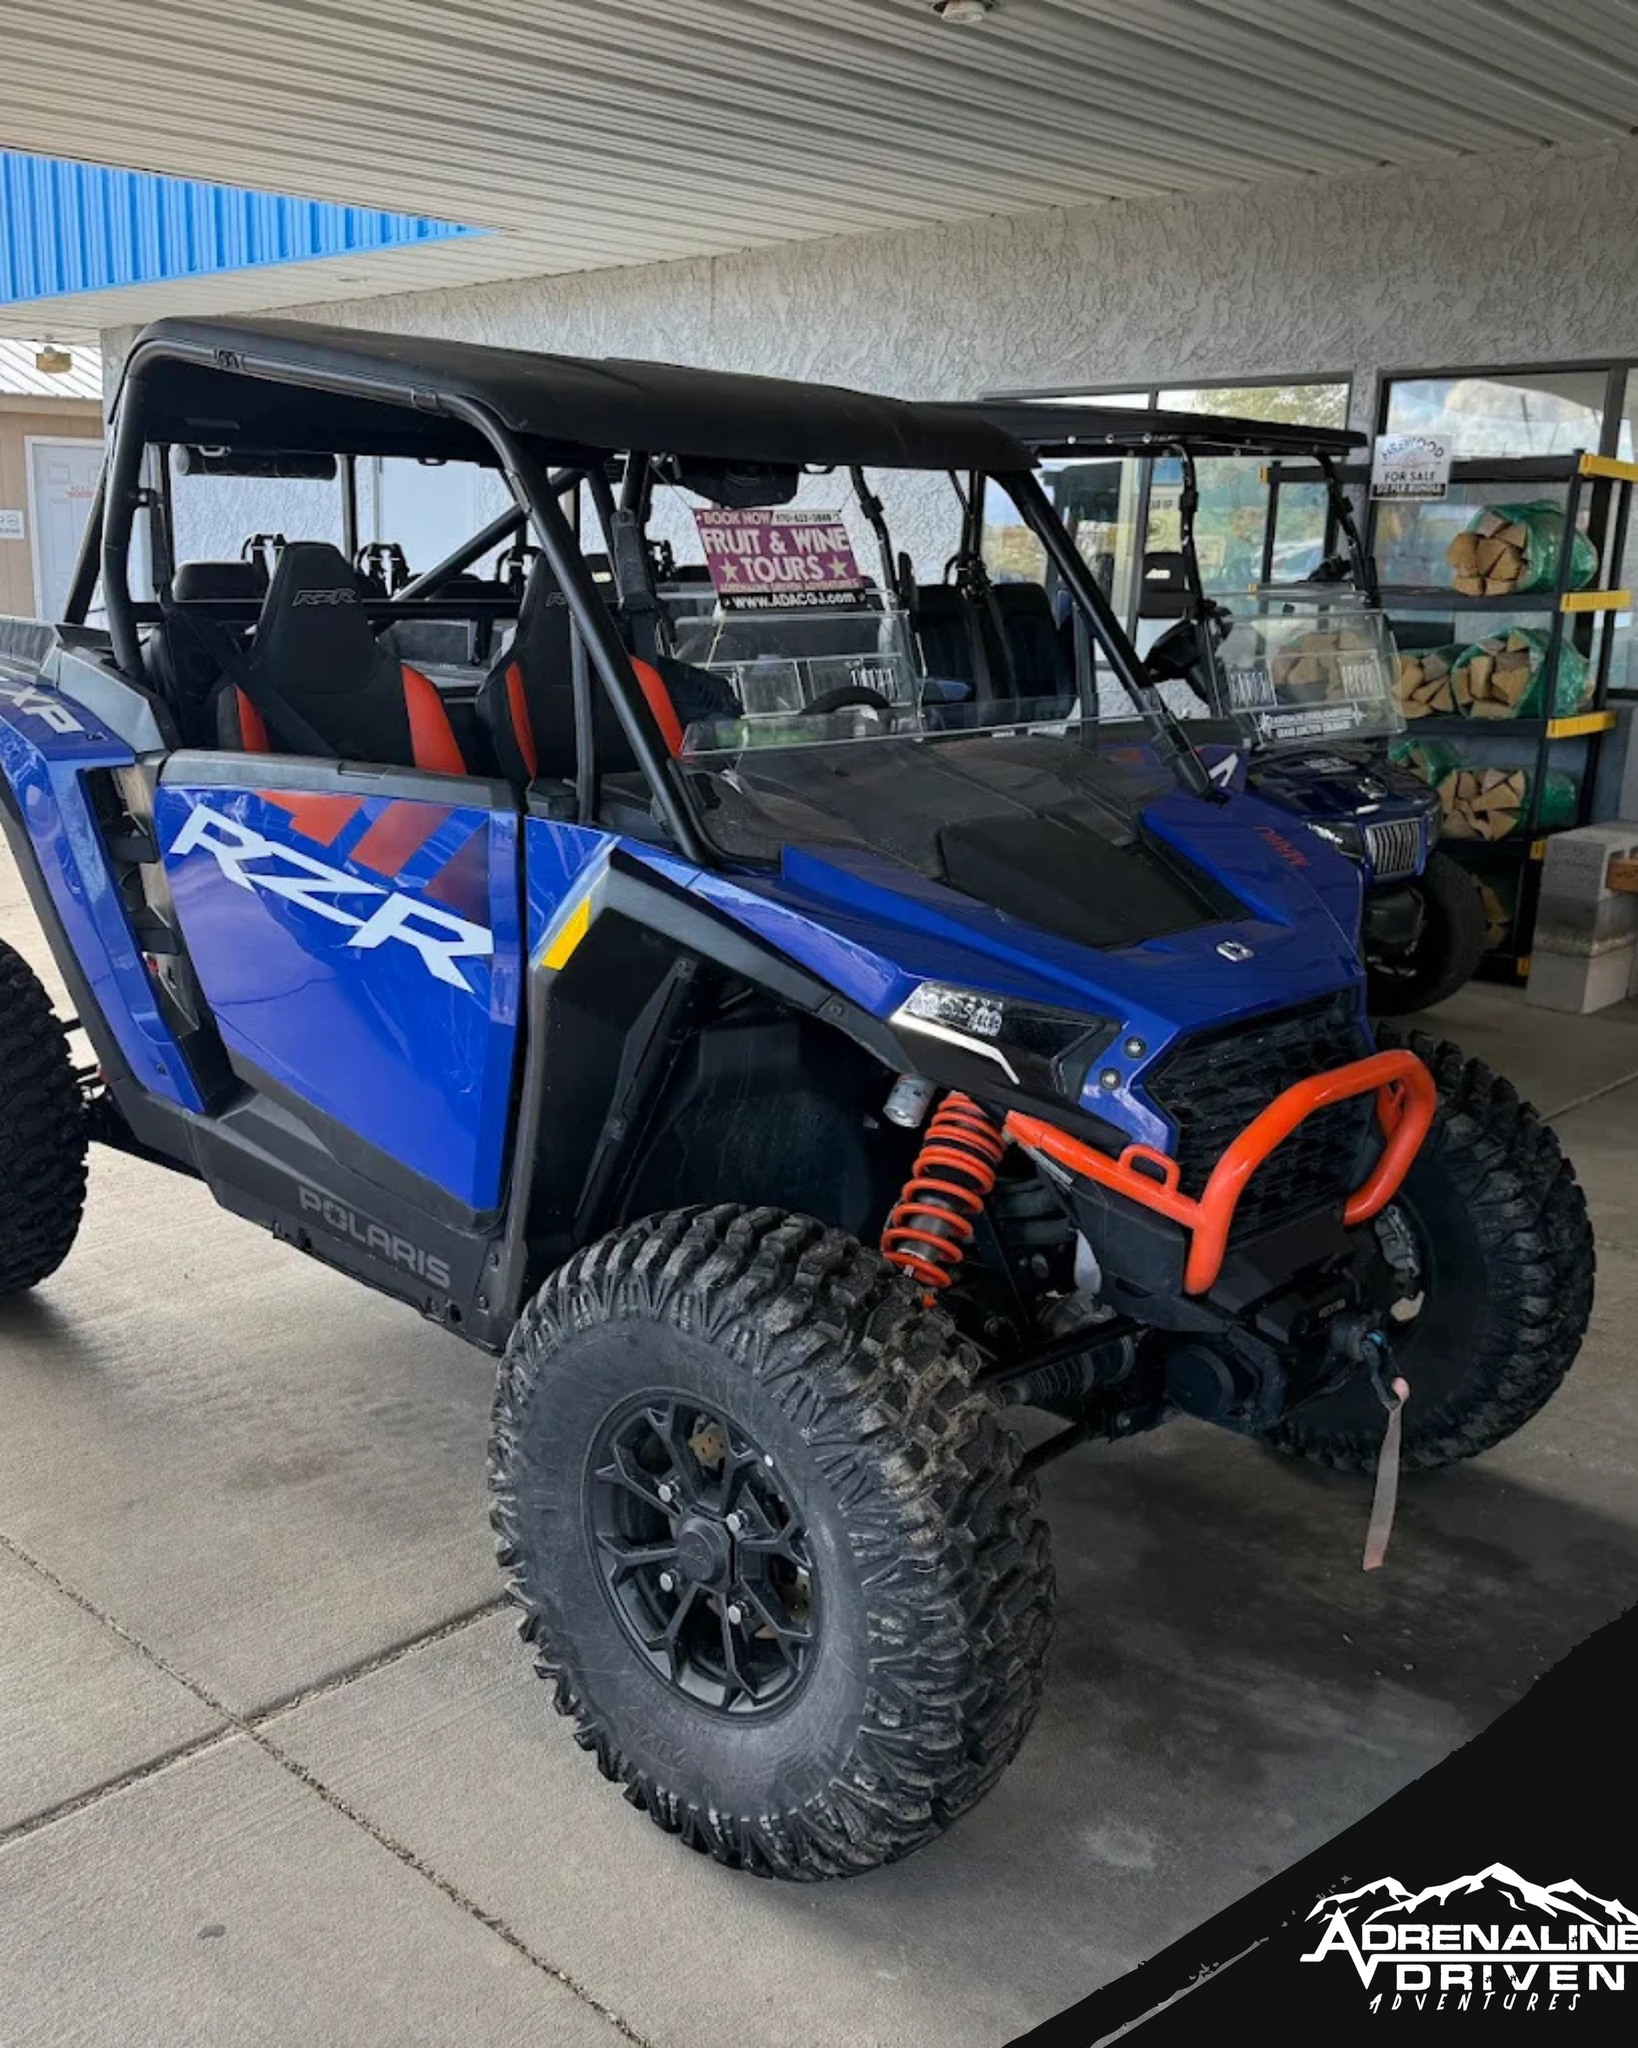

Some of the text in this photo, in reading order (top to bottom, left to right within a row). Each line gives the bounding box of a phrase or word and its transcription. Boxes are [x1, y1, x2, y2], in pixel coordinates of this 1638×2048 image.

[1385, 471, 1435, 482] FOR SALE
[704, 513, 742, 525] BOOK
[743, 513, 771, 525] NOW
[702, 525, 850, 555] FRUIT & WINE
[740, 557, 823, 582] TOURS
[168, 803, 494, 994] RZR
[299, 1186, 450, 1288] POLARIS
